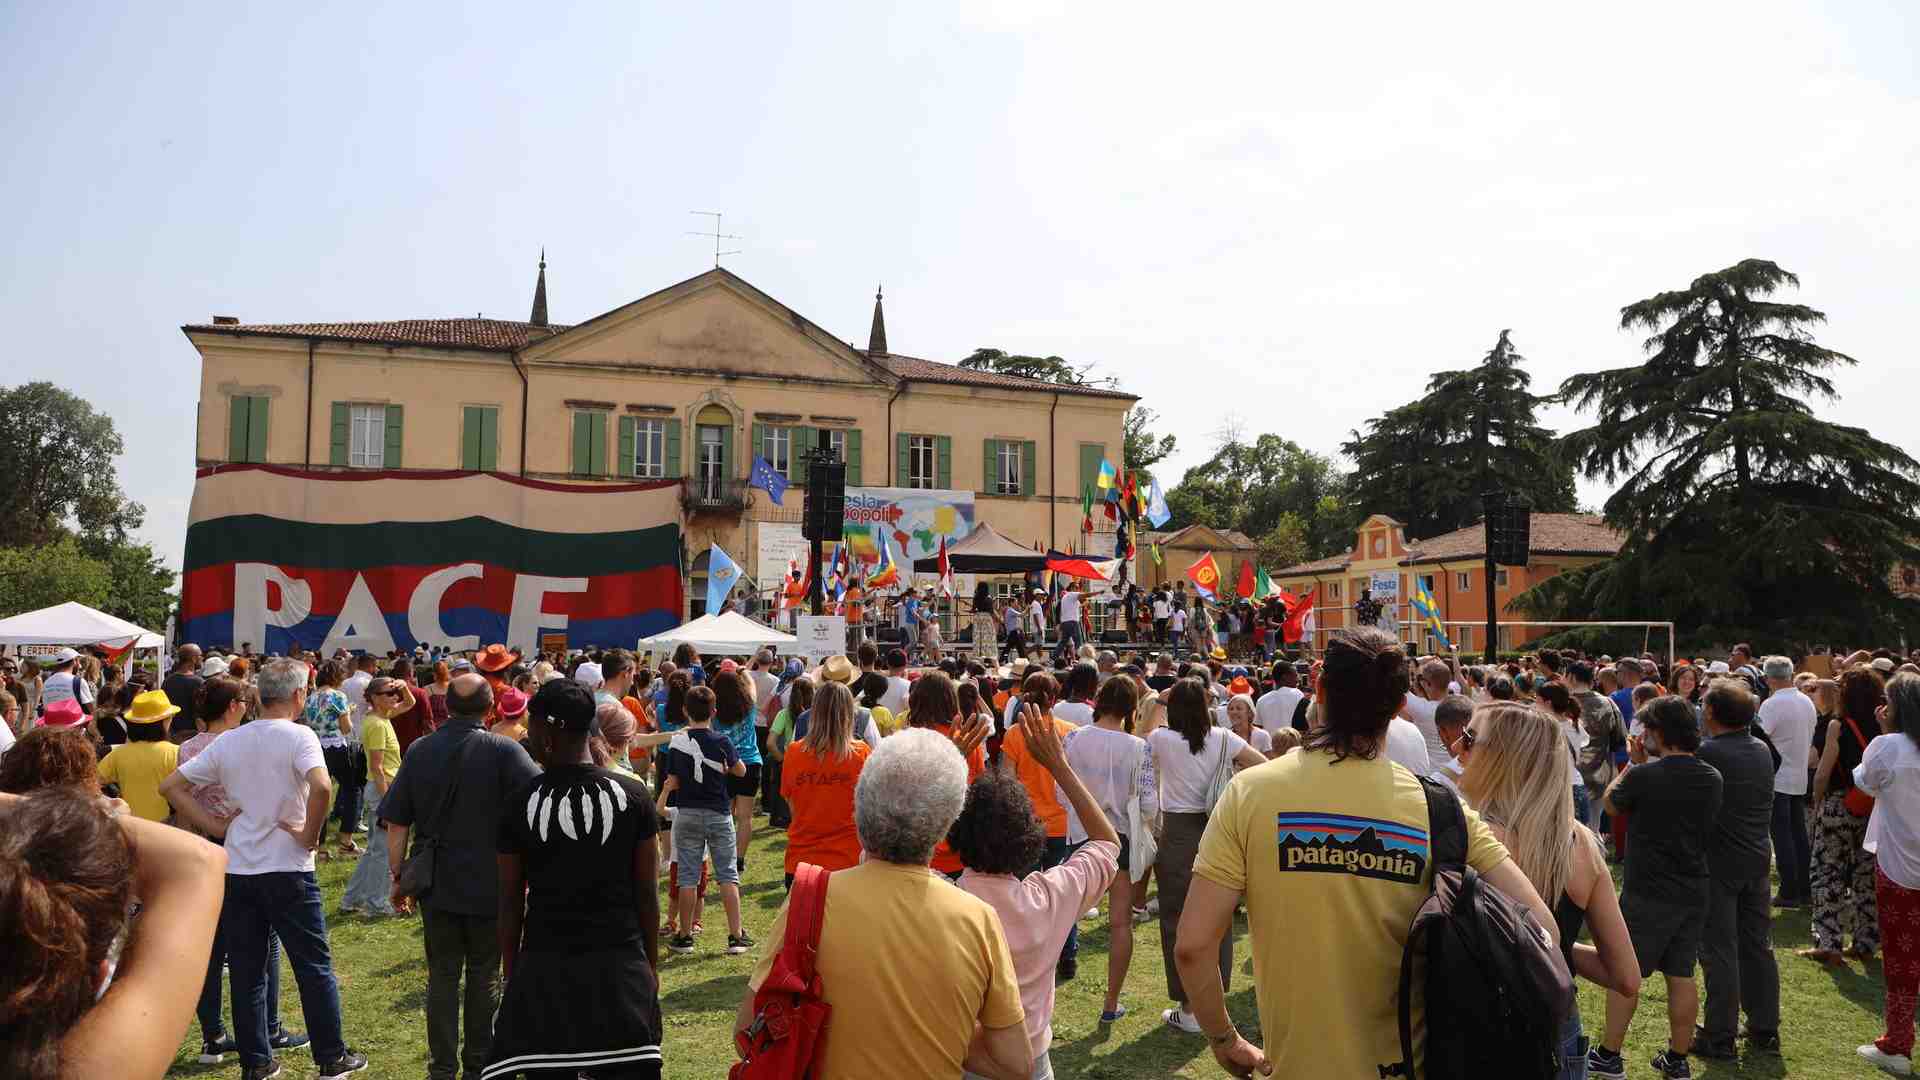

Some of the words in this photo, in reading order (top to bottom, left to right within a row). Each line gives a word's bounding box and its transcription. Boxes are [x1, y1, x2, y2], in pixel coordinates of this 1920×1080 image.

[1372, 579, 1397, 590] Festa
[27, 646, 62, 656] ERITRE
[1287, 845, 1416, 877] patagonia
